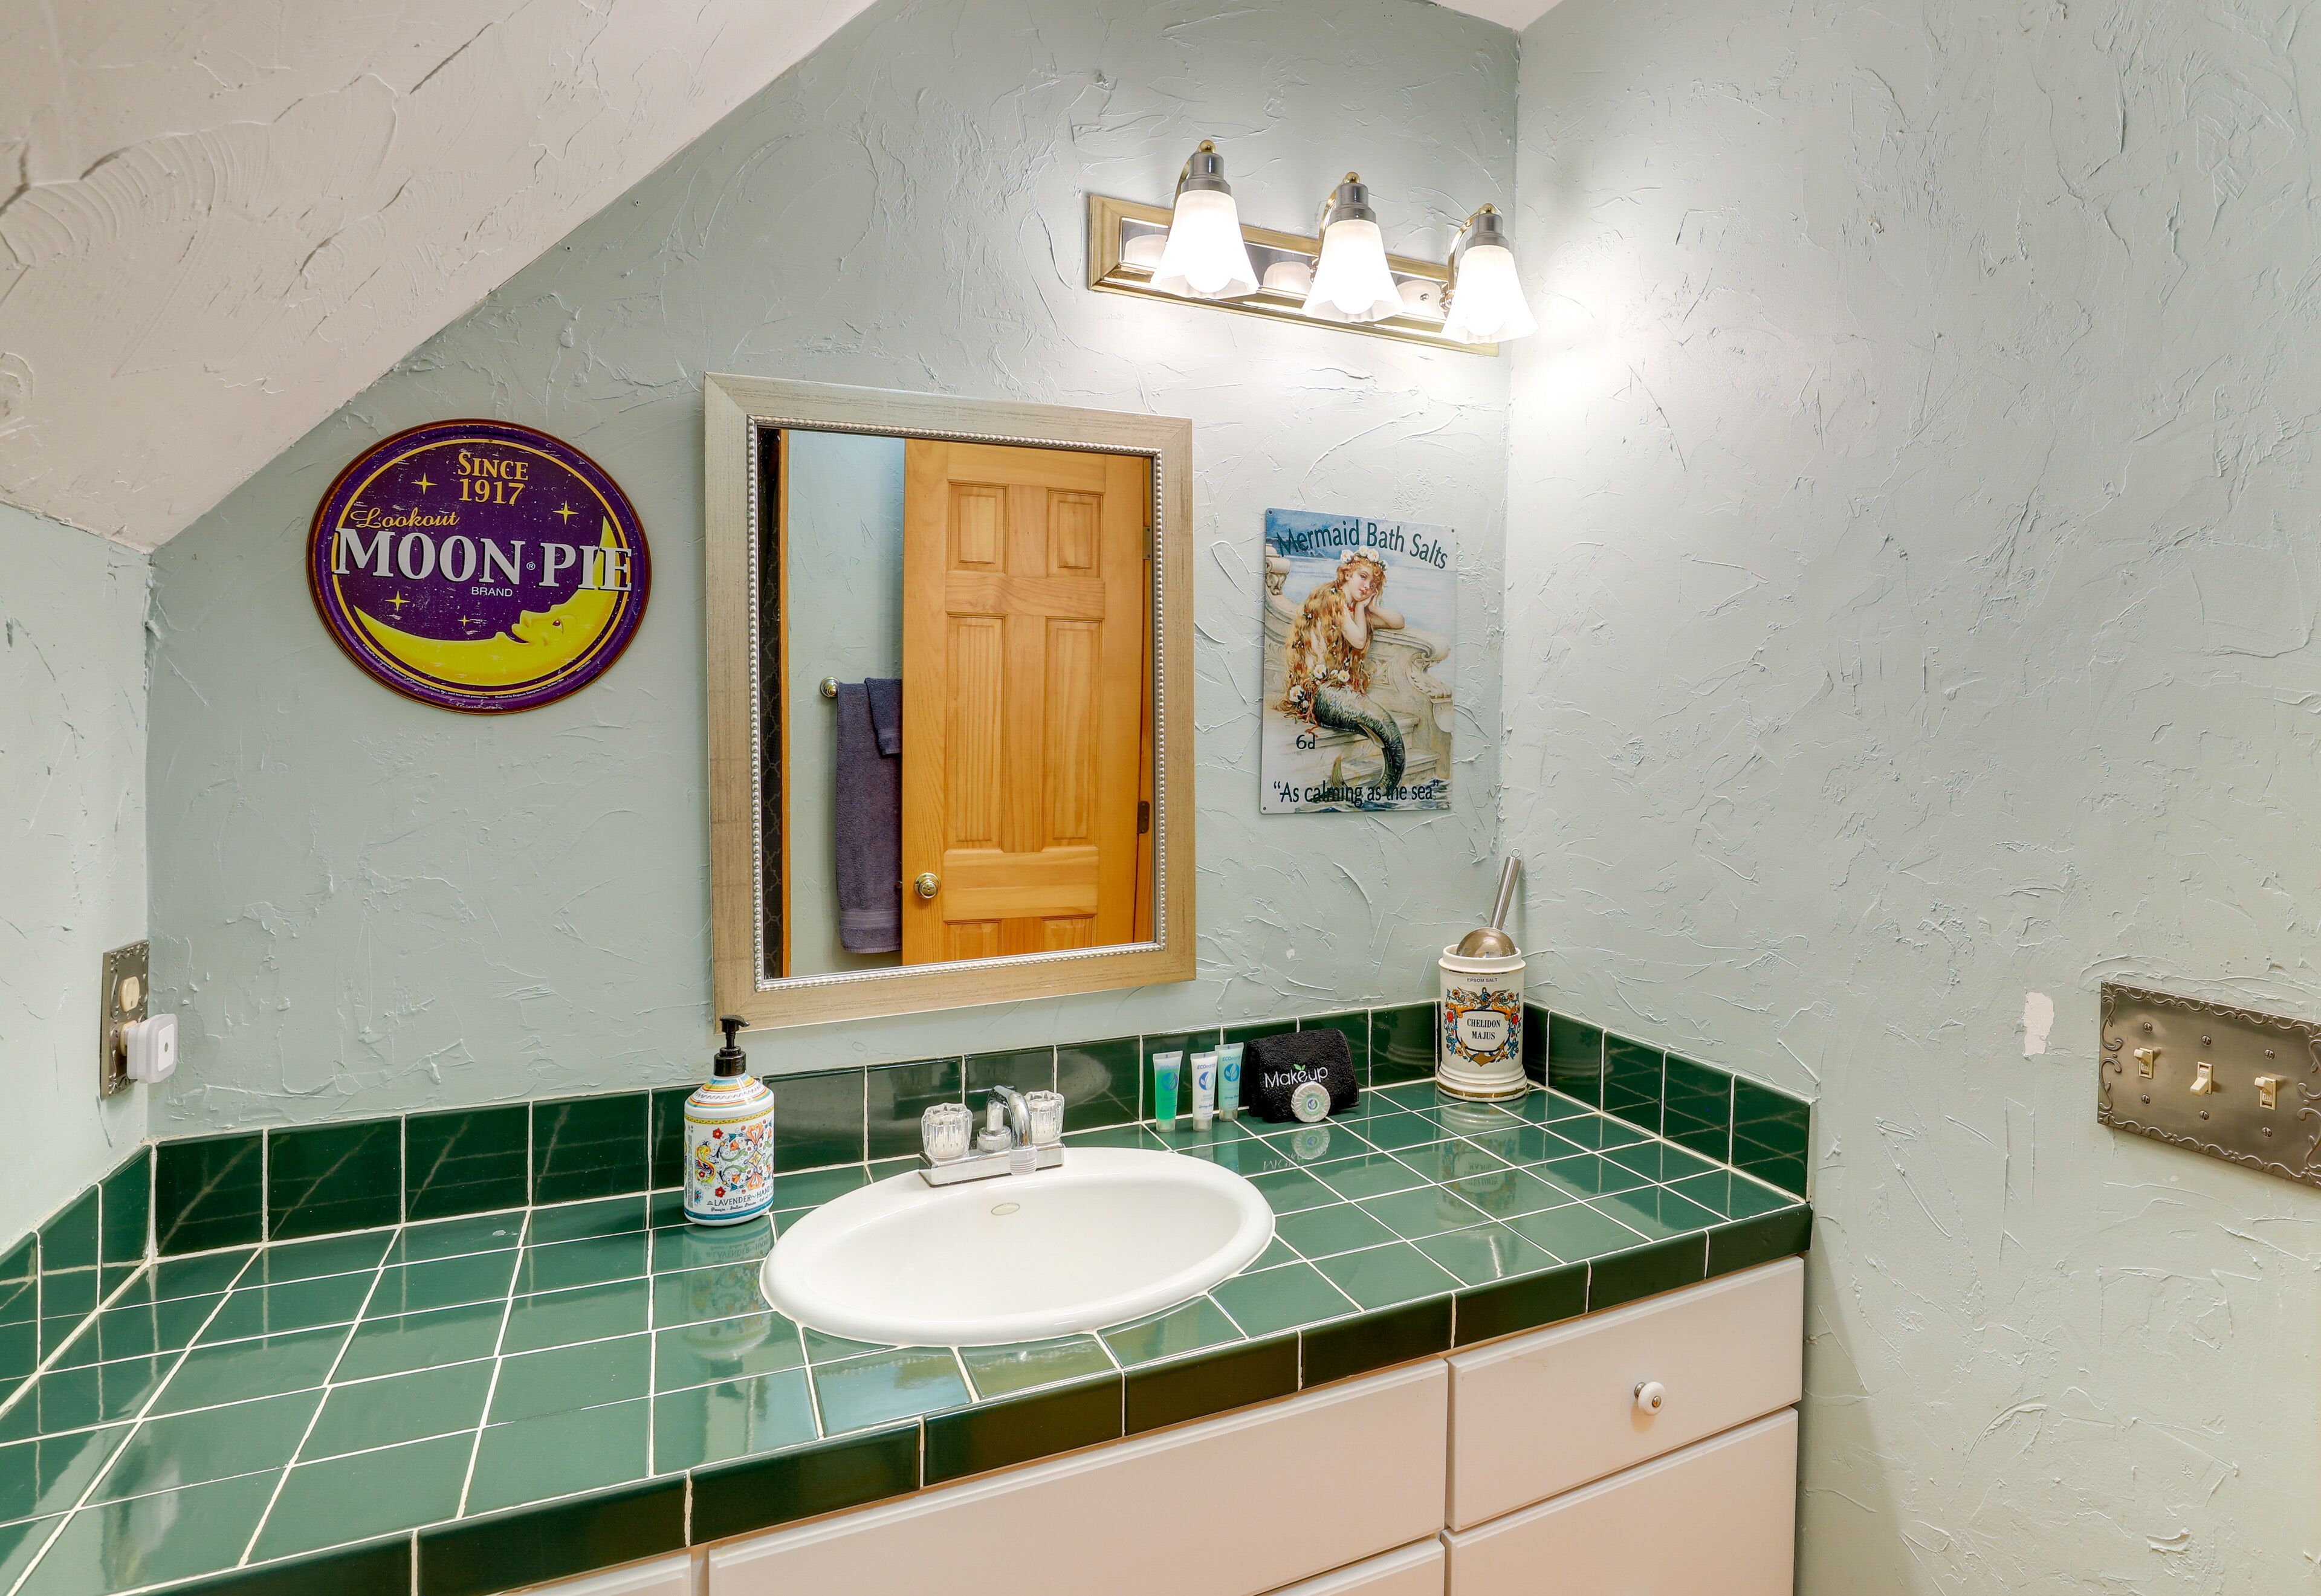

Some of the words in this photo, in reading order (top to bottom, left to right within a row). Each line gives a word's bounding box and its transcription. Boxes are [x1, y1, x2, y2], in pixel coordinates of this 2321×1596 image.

[458, 451, 529, 480] SINCE
[459, 478, 525, 505] 1917
[350, 506, 461, 529] Lookout
[1276, 519, 1360, 557] Mermaid
[1367, 522, 1405, 552] Bath
[1409, 532, 1448, 570] Salts
[334, 527, 526, 586] MOON
[538, 541, 632, 592] PIE
[471, 586, 514, 598] BRAND
[1296, 734, 1316, 751] 6d
[1304, 780, 1363, 808] calming
[1367, 786, 1382, 801] as
[1386, 783, 1408, 801] the
[1467, 1018, 1501, 1028] CHELIDON
[1472, 1031, 1495, 1039] MAJUS
[1264, 1067, 1329, 1088] Makeup
[714, 1194, 751, 1206] LAVENDER
